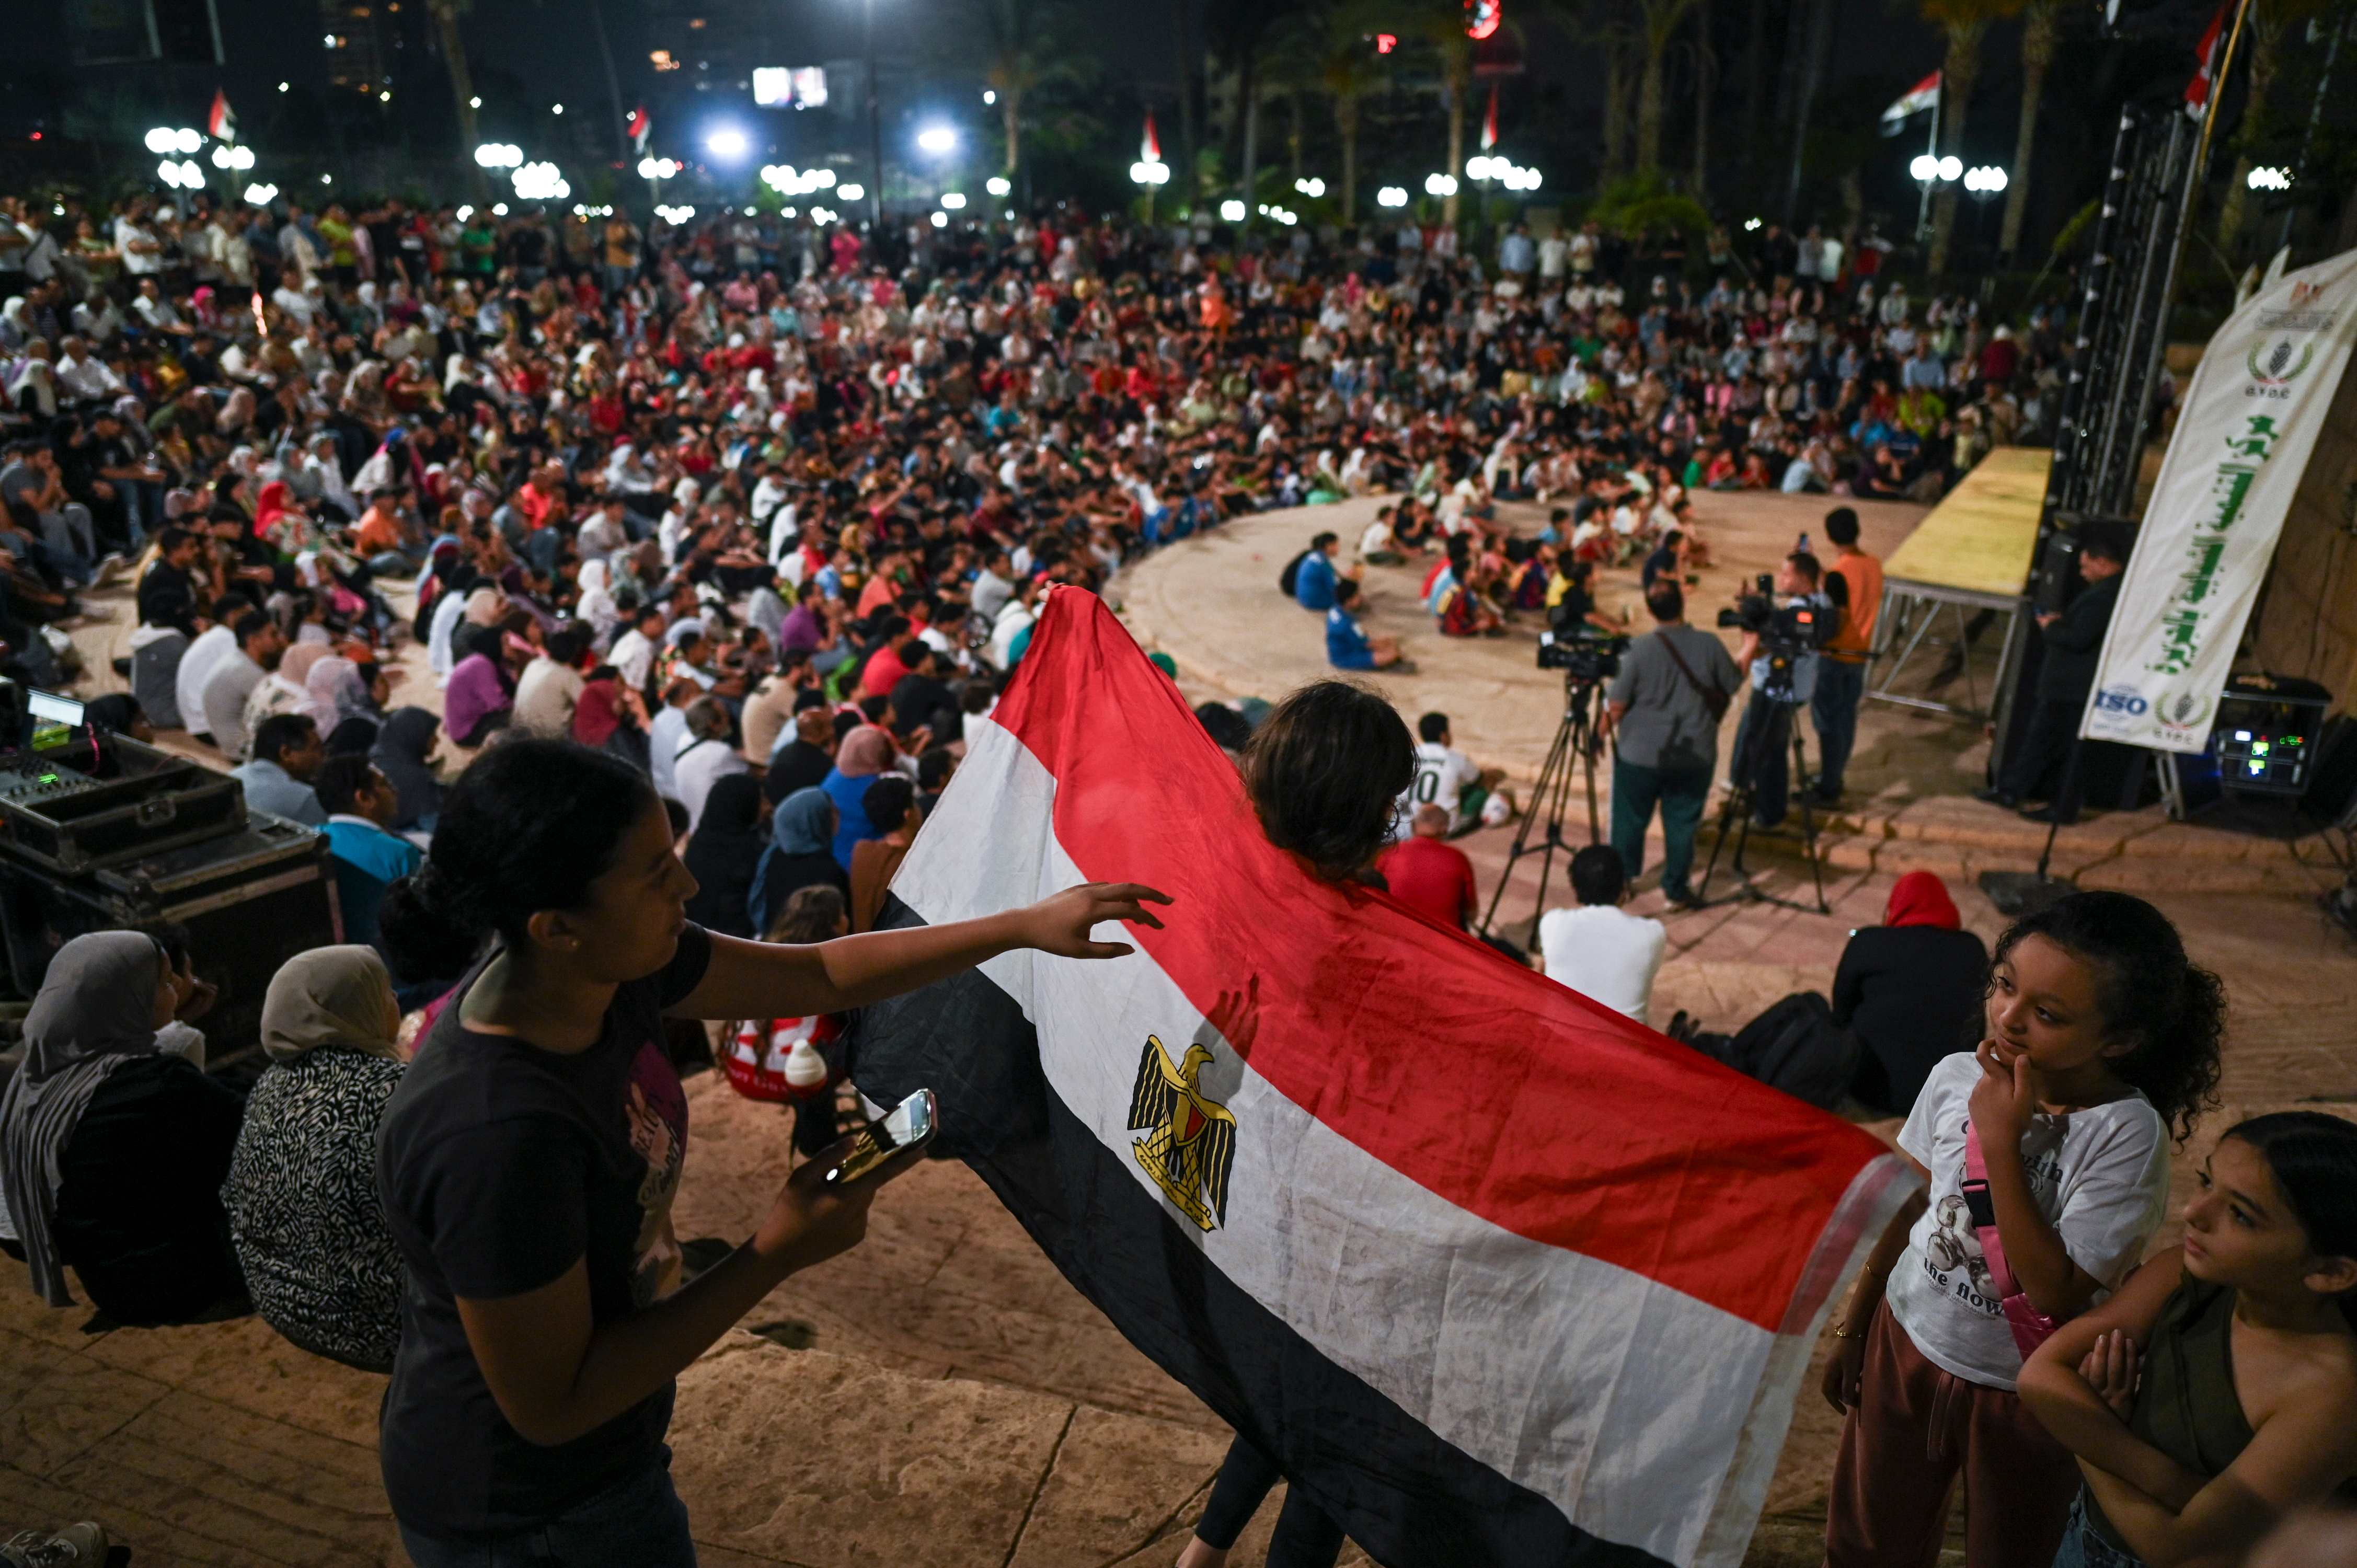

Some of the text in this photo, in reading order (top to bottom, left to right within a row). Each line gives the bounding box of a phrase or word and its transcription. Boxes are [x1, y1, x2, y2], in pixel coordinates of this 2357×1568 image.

[2226, 415, 2279, 462] مركز
[2195, 463, 2258, 532] التنمية
[2096, 689, 2148, 716] ISO
[1924, 1257, 1948, 1286] the
[1956, 1282, 2004, 1315] flow
